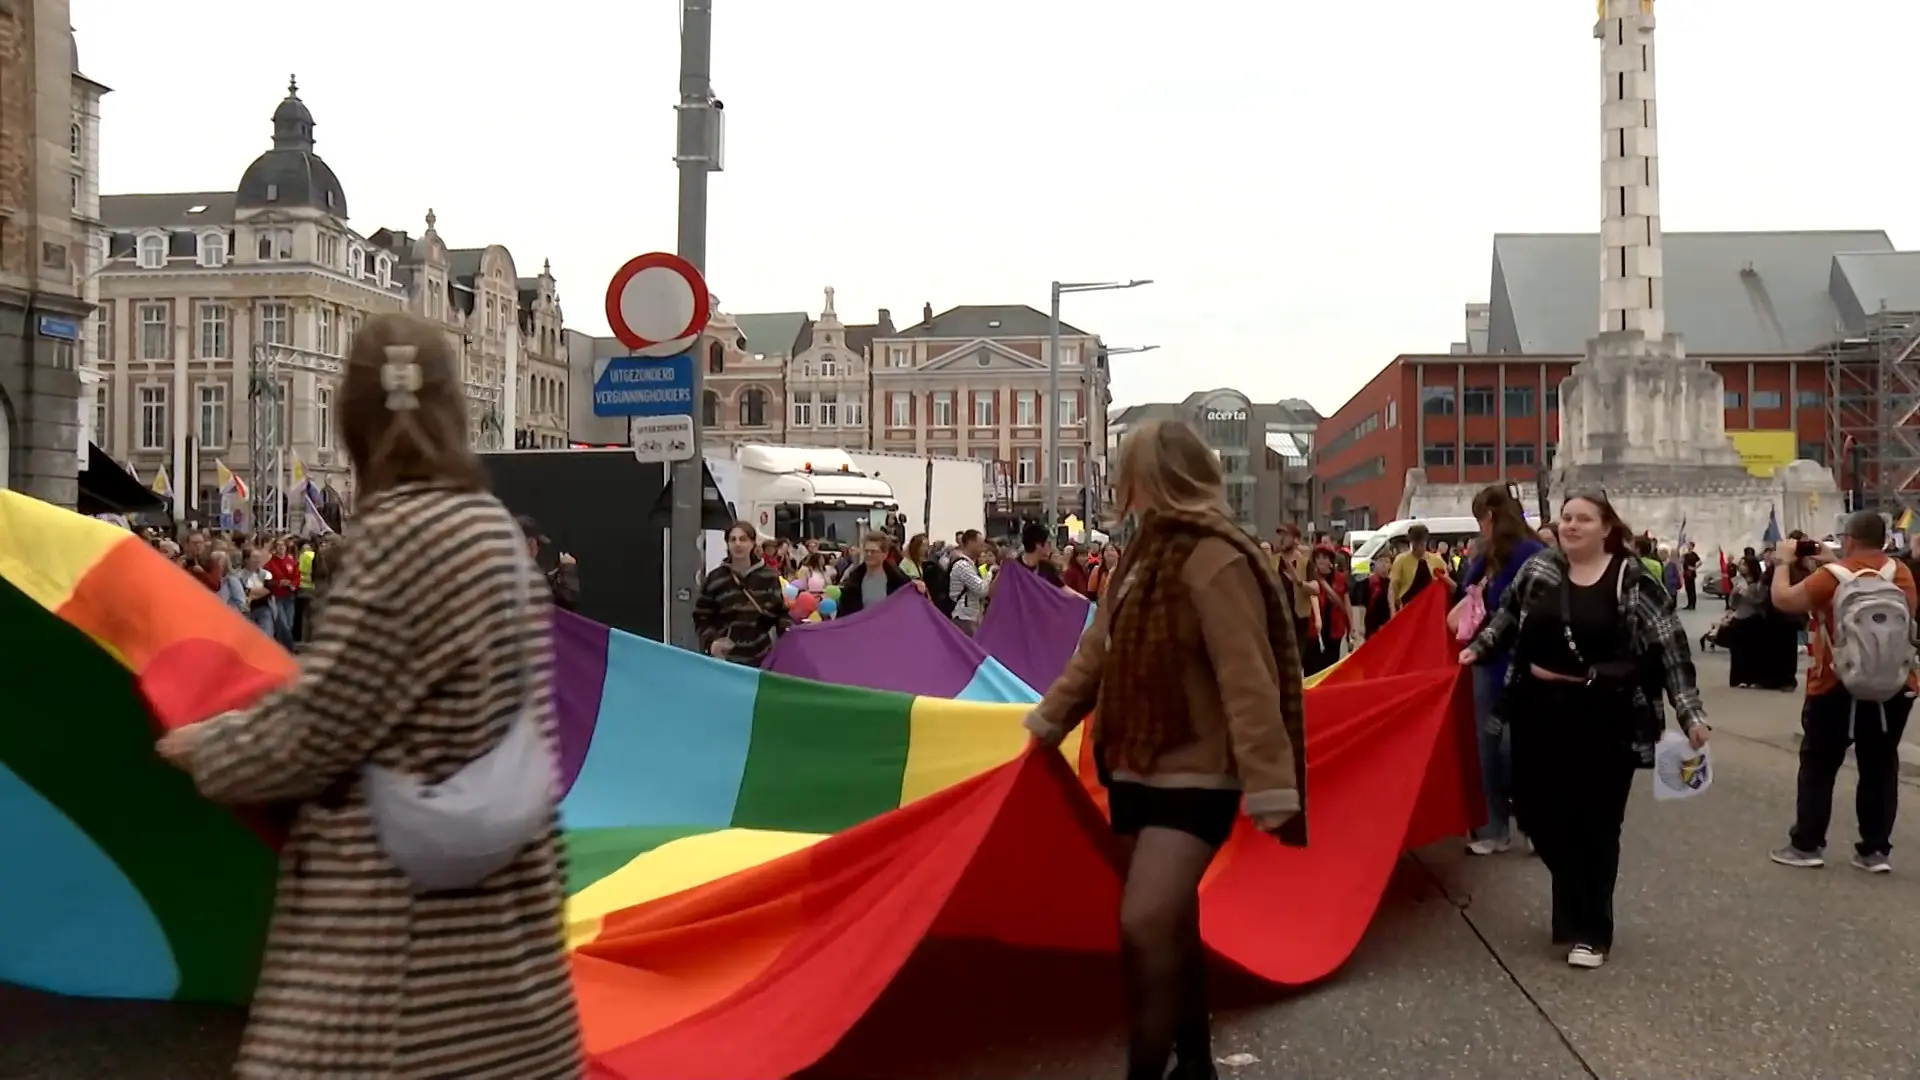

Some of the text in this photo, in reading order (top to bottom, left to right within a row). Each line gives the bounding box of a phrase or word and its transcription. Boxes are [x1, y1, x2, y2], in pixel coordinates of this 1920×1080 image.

[609, 367, 675, 384] UITGEZONDERD
[595, 388, 691, 404] VERGUNNINGHOUDERS
[1207, 411, 1247, 421] acerta
